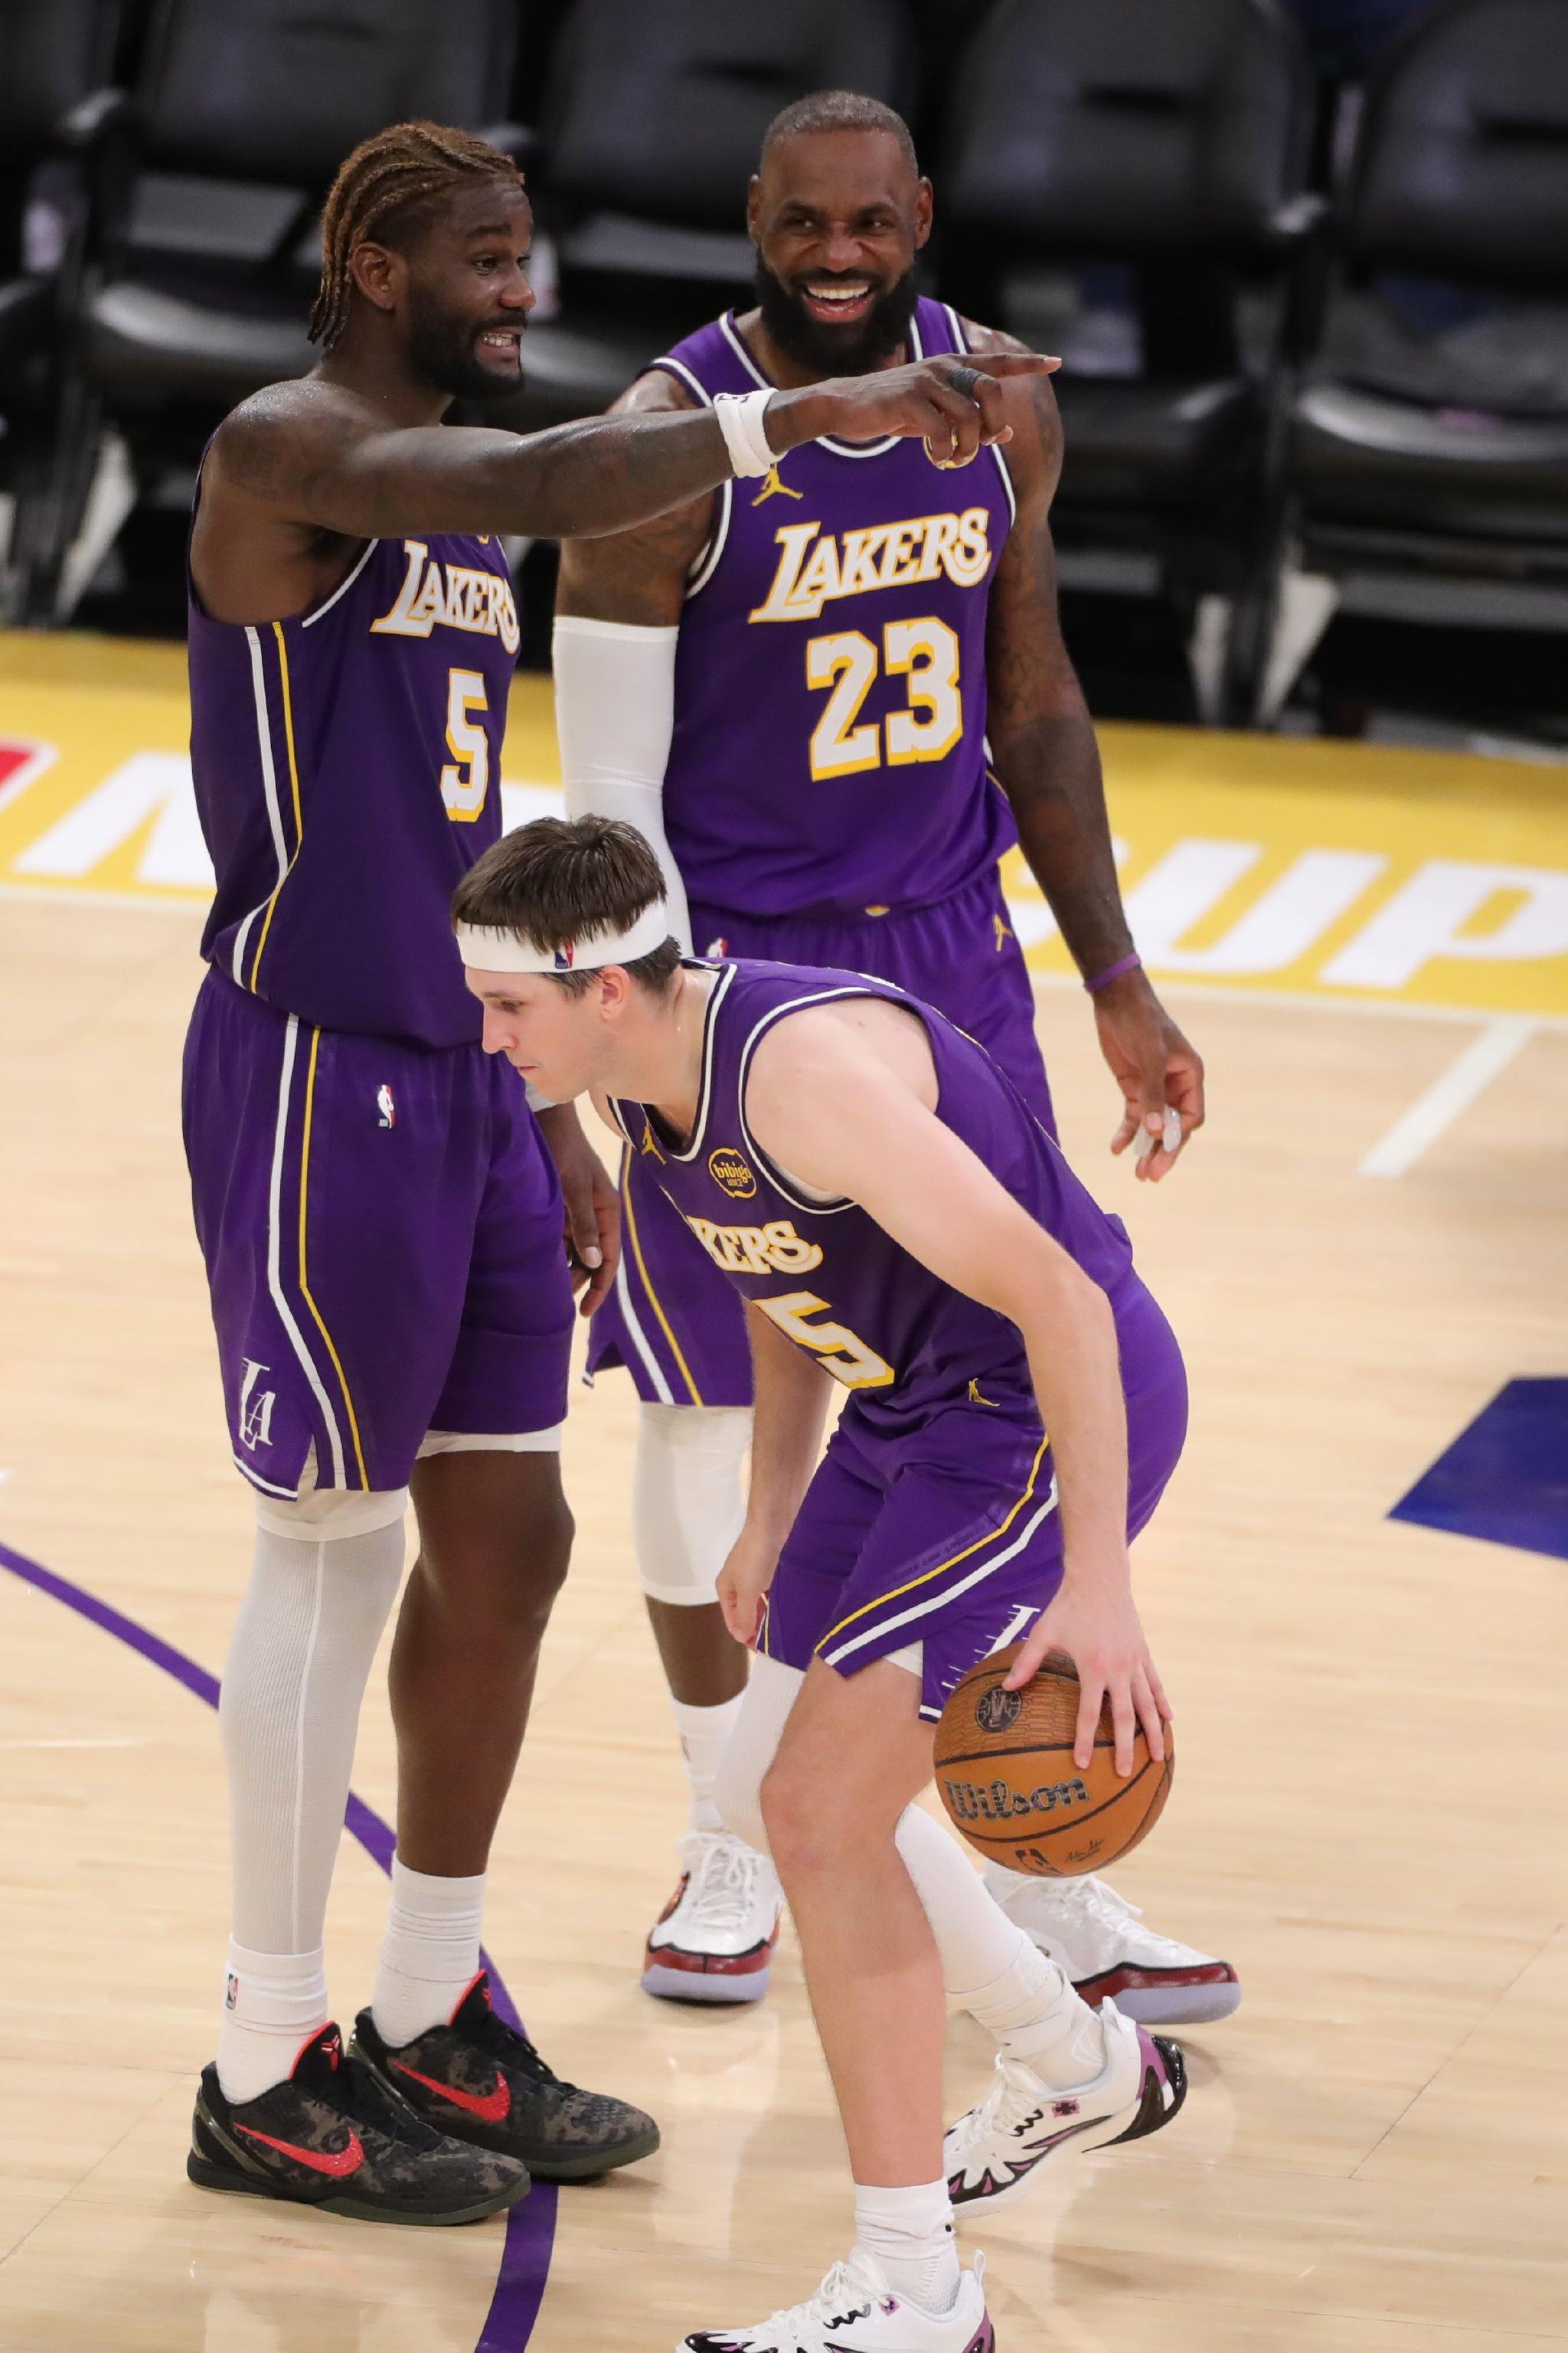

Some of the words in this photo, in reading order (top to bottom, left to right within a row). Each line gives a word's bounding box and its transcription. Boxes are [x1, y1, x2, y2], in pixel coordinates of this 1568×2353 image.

[369, 539, 521, 655] LAKERS
[747, 507, 992, 624] LAKERS
[439, 667, 489, 823] 5
[806, 616, 964, 783] 23
[713, 1161, 752, 1184] bibigo
[686, 1214, 824, 1274] KERS
[943, 1776, 1091, 1820] Wilson
